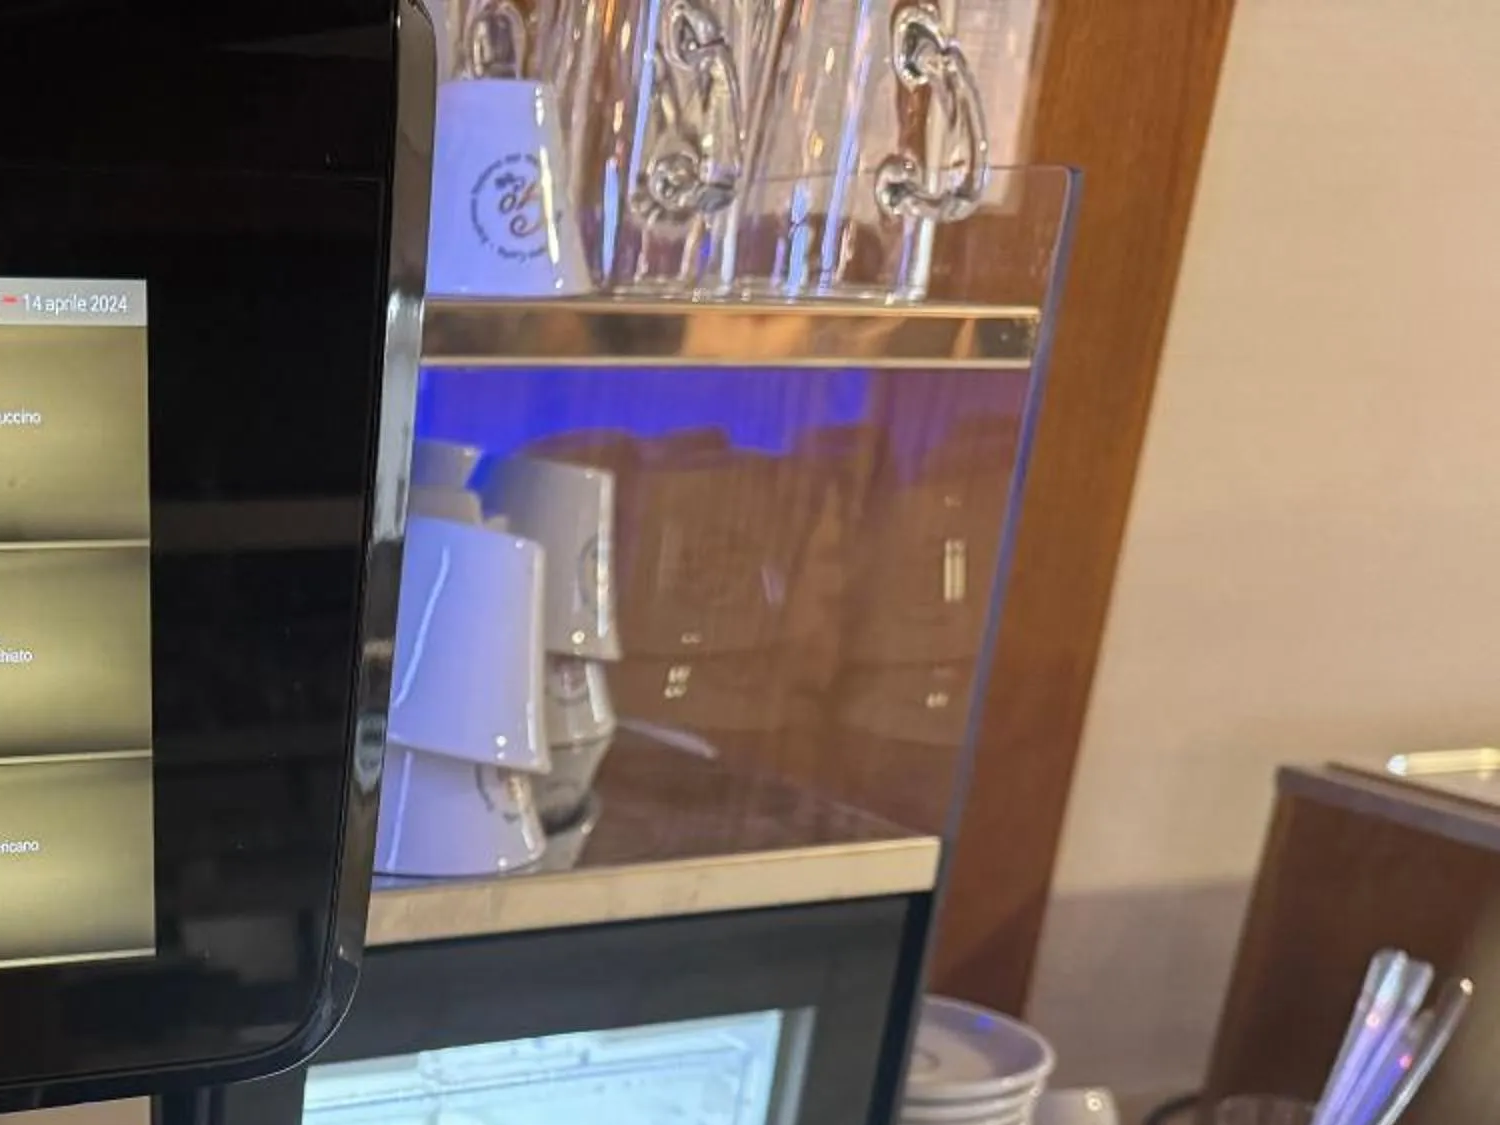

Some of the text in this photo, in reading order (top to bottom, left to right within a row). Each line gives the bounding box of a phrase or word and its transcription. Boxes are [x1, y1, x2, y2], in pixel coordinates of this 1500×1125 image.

[23, 294, 128, 316] 14 aprile 2024
